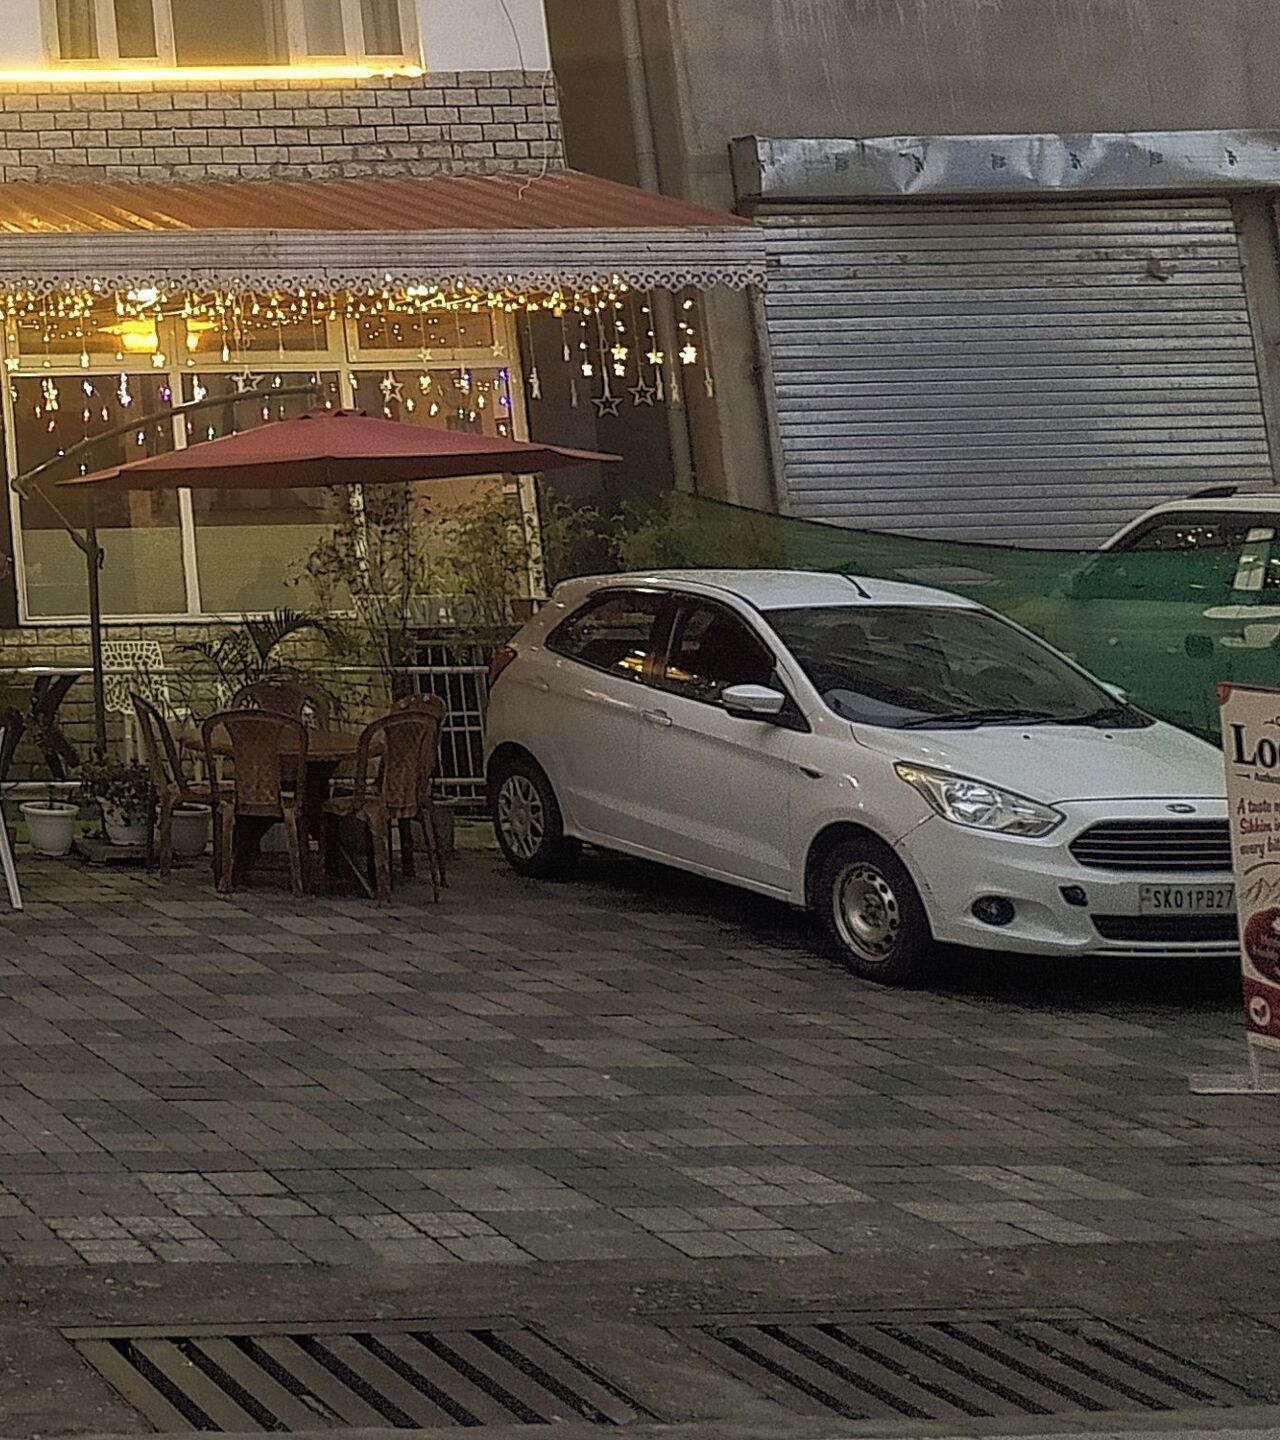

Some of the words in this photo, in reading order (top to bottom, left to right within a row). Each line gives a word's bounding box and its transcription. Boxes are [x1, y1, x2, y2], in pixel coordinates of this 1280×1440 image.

[1230, 723, 1280, 769] Lo
[1237, 797, 1246, 815] A
[1248, 800, 1272, 813] taste
[1240, 843, 1265, 859] every
